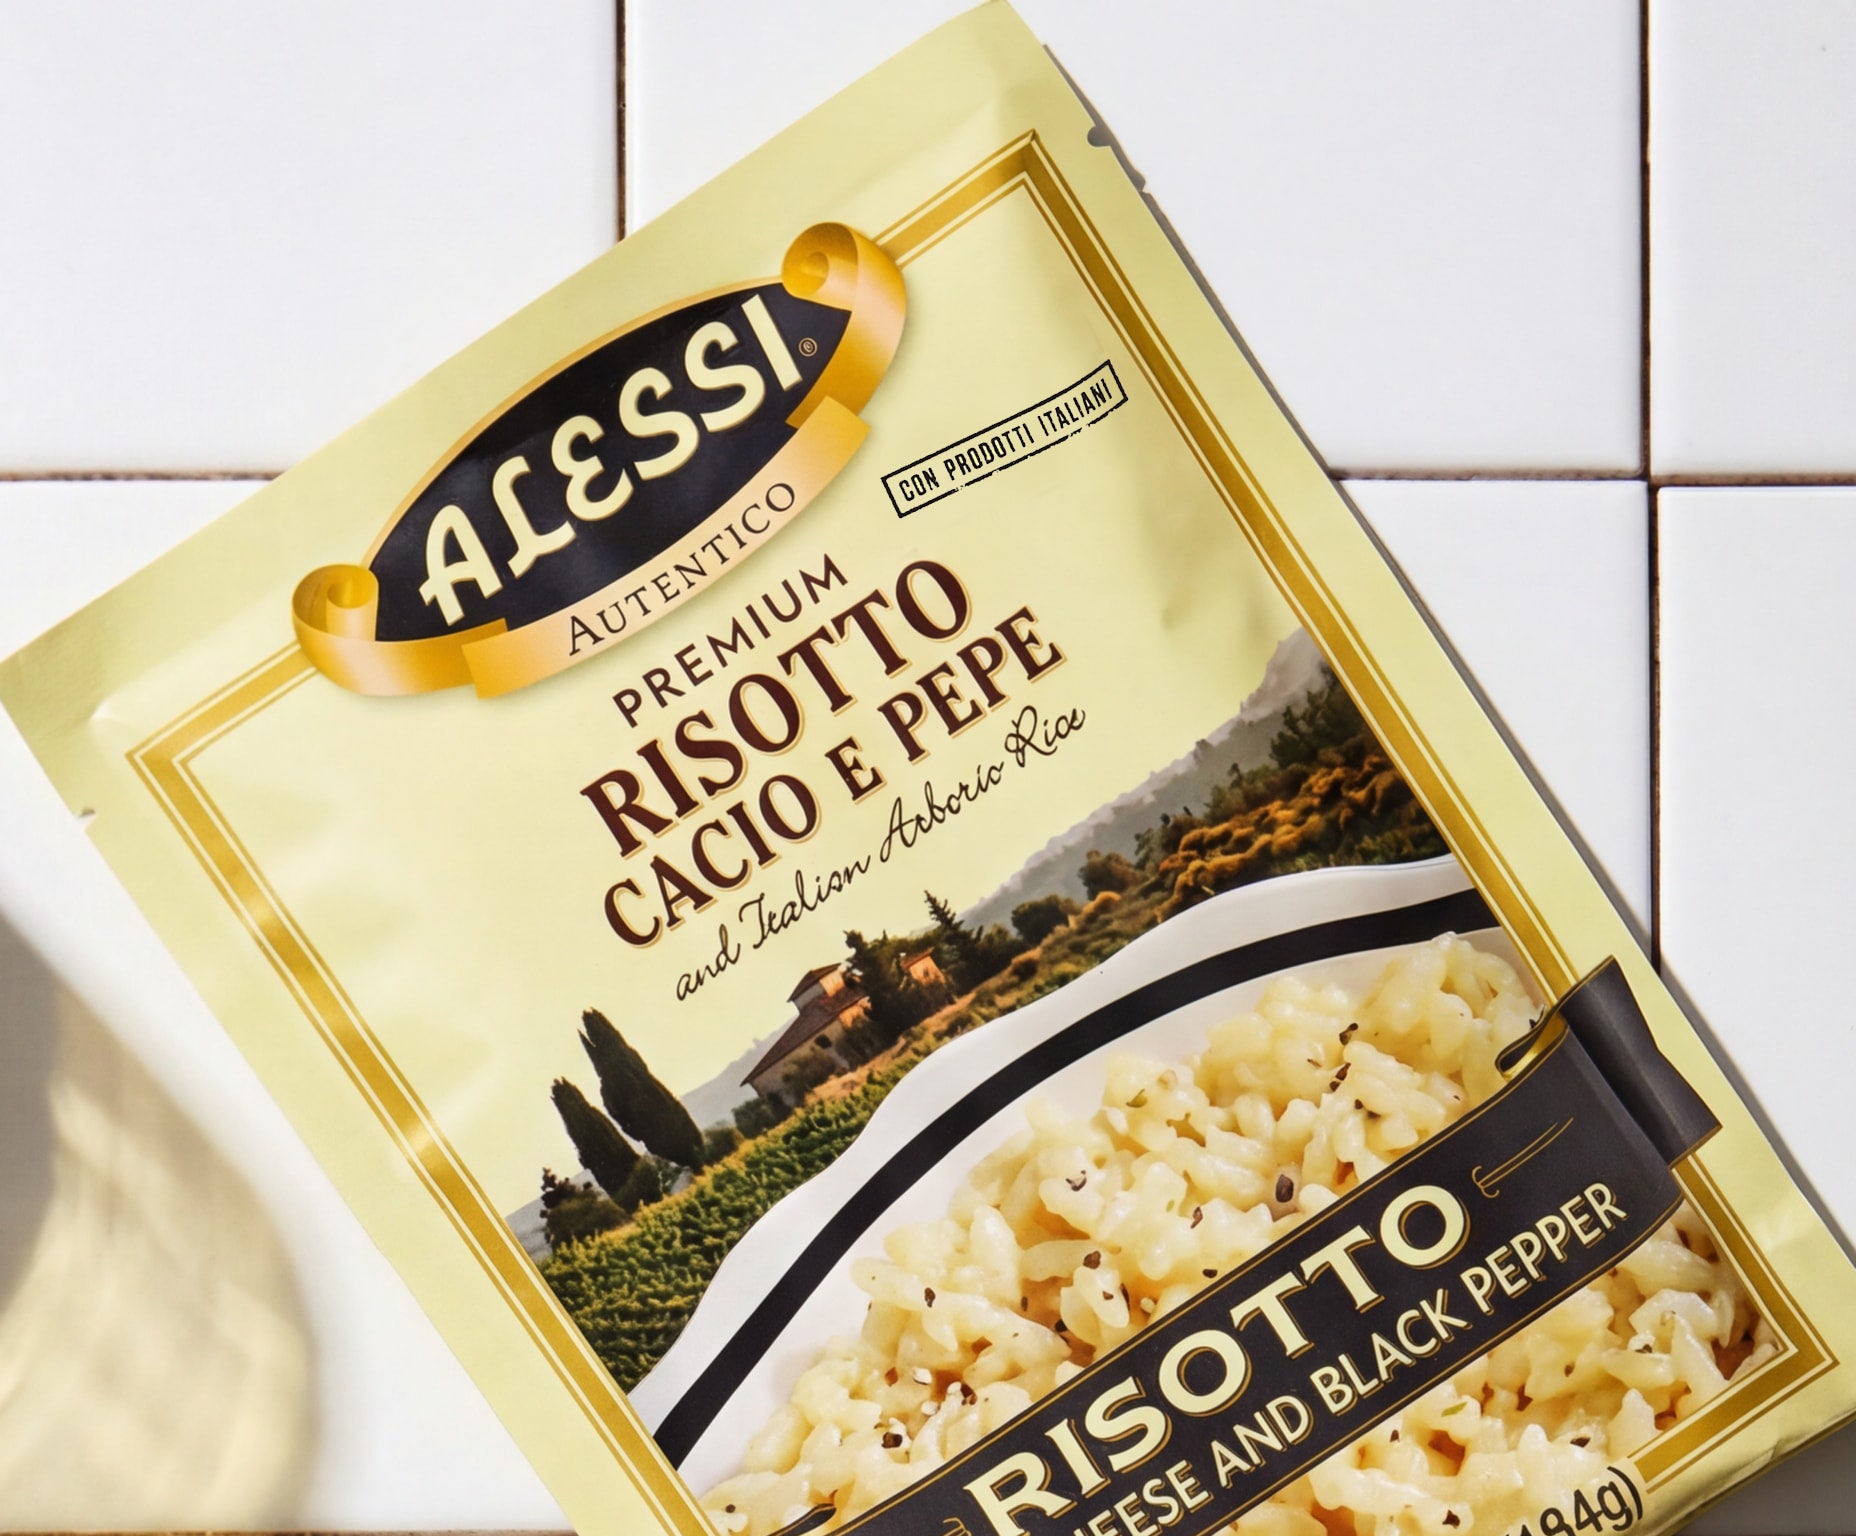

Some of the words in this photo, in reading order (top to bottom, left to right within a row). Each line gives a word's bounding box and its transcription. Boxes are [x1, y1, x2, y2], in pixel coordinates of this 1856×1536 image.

[419, 294, 804, 627] ALESSI
[567, 482, 797, 657] AUTENTICO
[899, 467, 940, 502] CON
[943, 423, 1035, 480] PRODOTTI
[1038, 378, 1113, 436] ITALIANI
[580, 560, 970, 859] RISOTTO
[603, 773, 820, 947] CACIO
[825, 735, 885, 803] E
[878, 605, 1064, 763] PEPE
[613, 553, 849, 728] PREMIUM
[676, 923, 741, 1001] and
[1004, 705, 1086, 767] Rice
[1209, 1393, 1313, 1491] AND
[1308, 1287, 1470, 1417] BLACK
[1464, 1181, 1628, 1323] PEPPER
